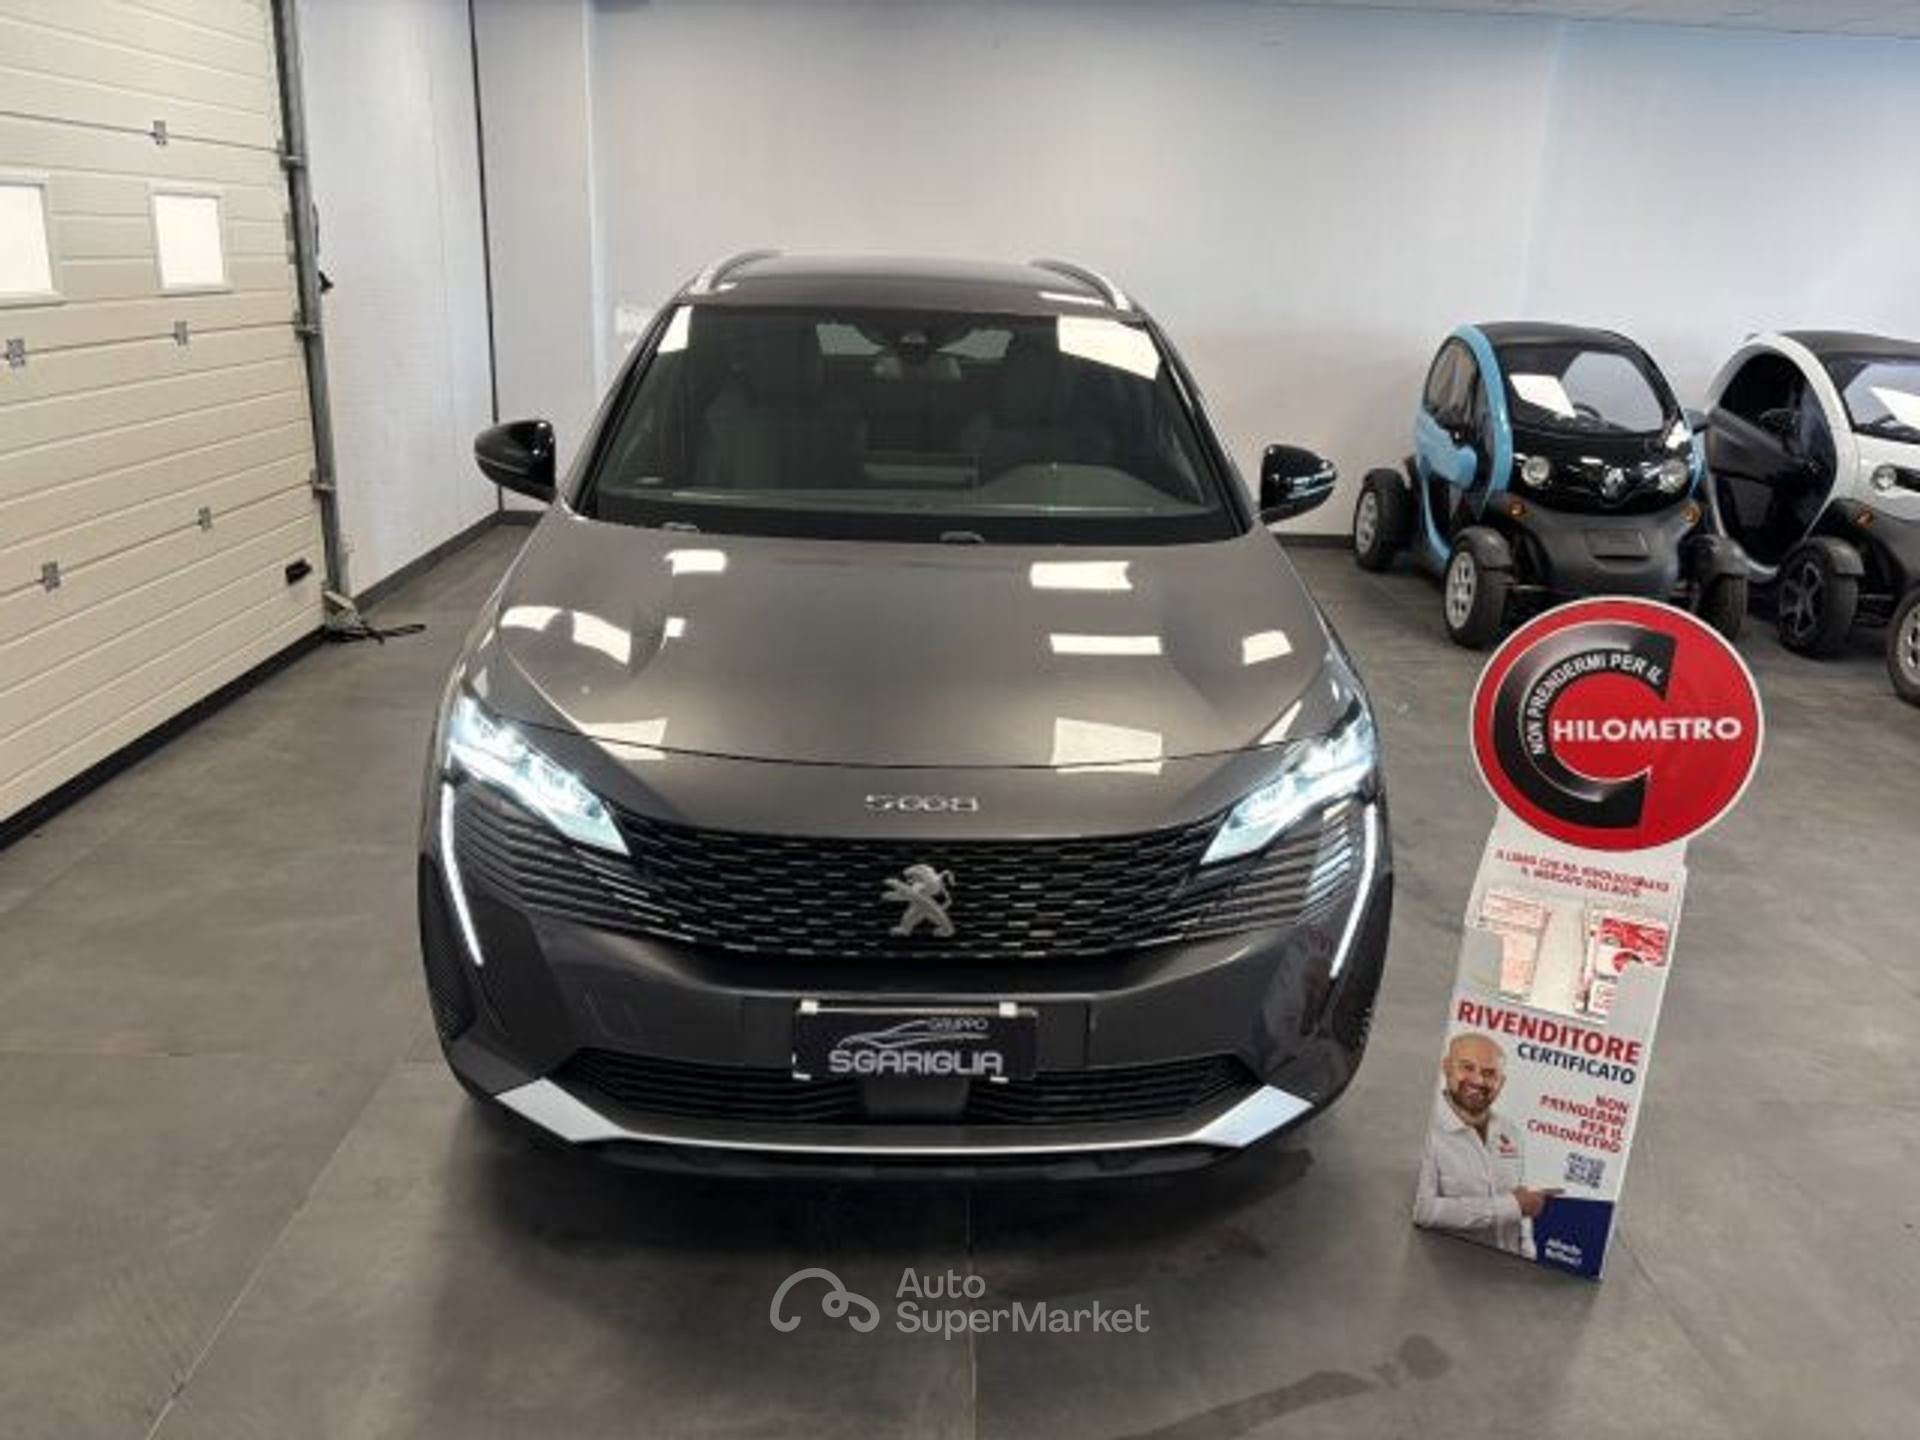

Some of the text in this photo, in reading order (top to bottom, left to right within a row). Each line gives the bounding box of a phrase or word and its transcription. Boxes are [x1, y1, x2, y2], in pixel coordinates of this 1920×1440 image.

[1527, 653, 1606, 717] PRENDERMI
[1610, 653, 1648, 673] PER
[866, 794, 979, 811] 5008
[927, 1018, 988, 1031] GRUPPO
[1457, 1001, 1643, 1066] RIVENDITORE
[829, 1050, 1004, 1075] SGARIGLIA
[1517, 1043, 1636, 1085] CERTIFICATO
[1540, 1095, 1627, 1129] PRENDERMI
[1596, 1094, 1629, 1114] NON
